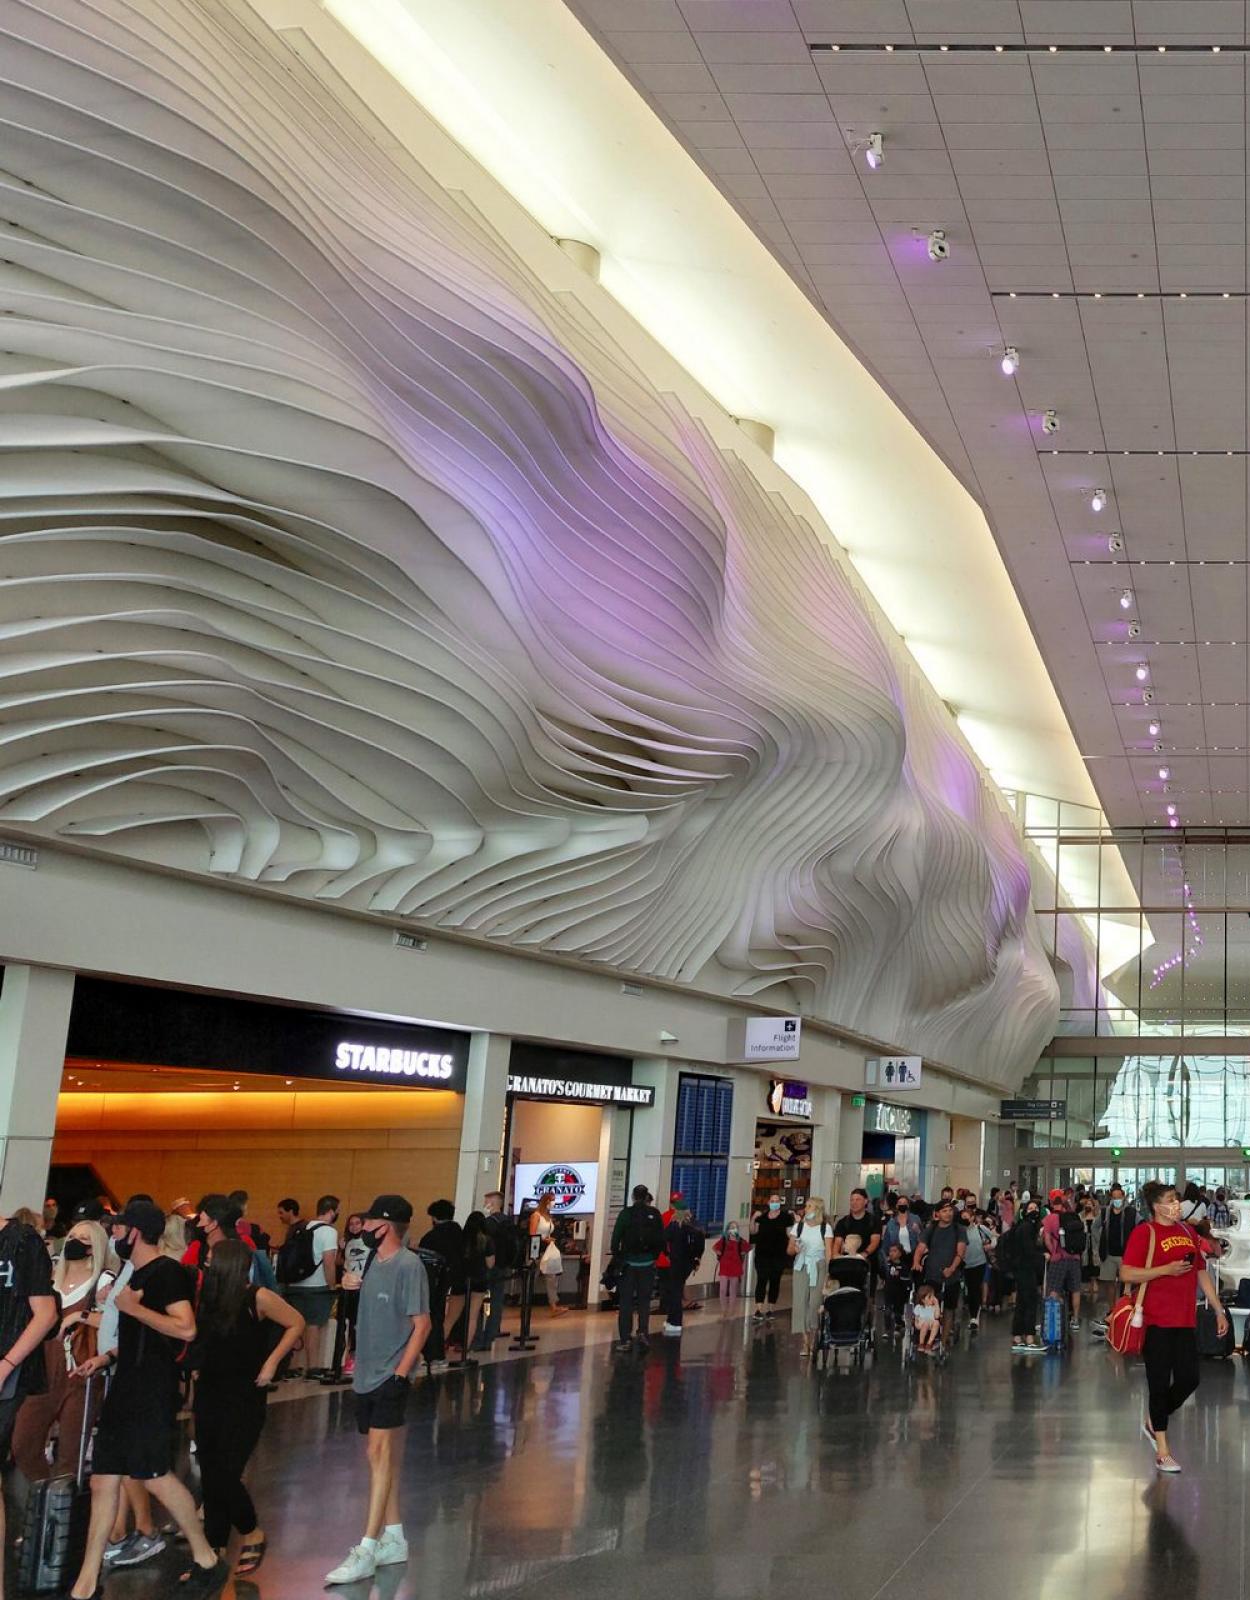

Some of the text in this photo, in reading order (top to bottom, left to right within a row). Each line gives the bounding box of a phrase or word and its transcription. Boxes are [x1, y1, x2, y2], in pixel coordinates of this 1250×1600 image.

[773, 1033, 796, 1043] Flight
[750, 1044, 796, 1052] Information
[335, 1042, 453, 1079] STARBUCKS
[564, 1081, 614, 1100] GOURMET
[613, 1085, 652, 1103] MARKET
